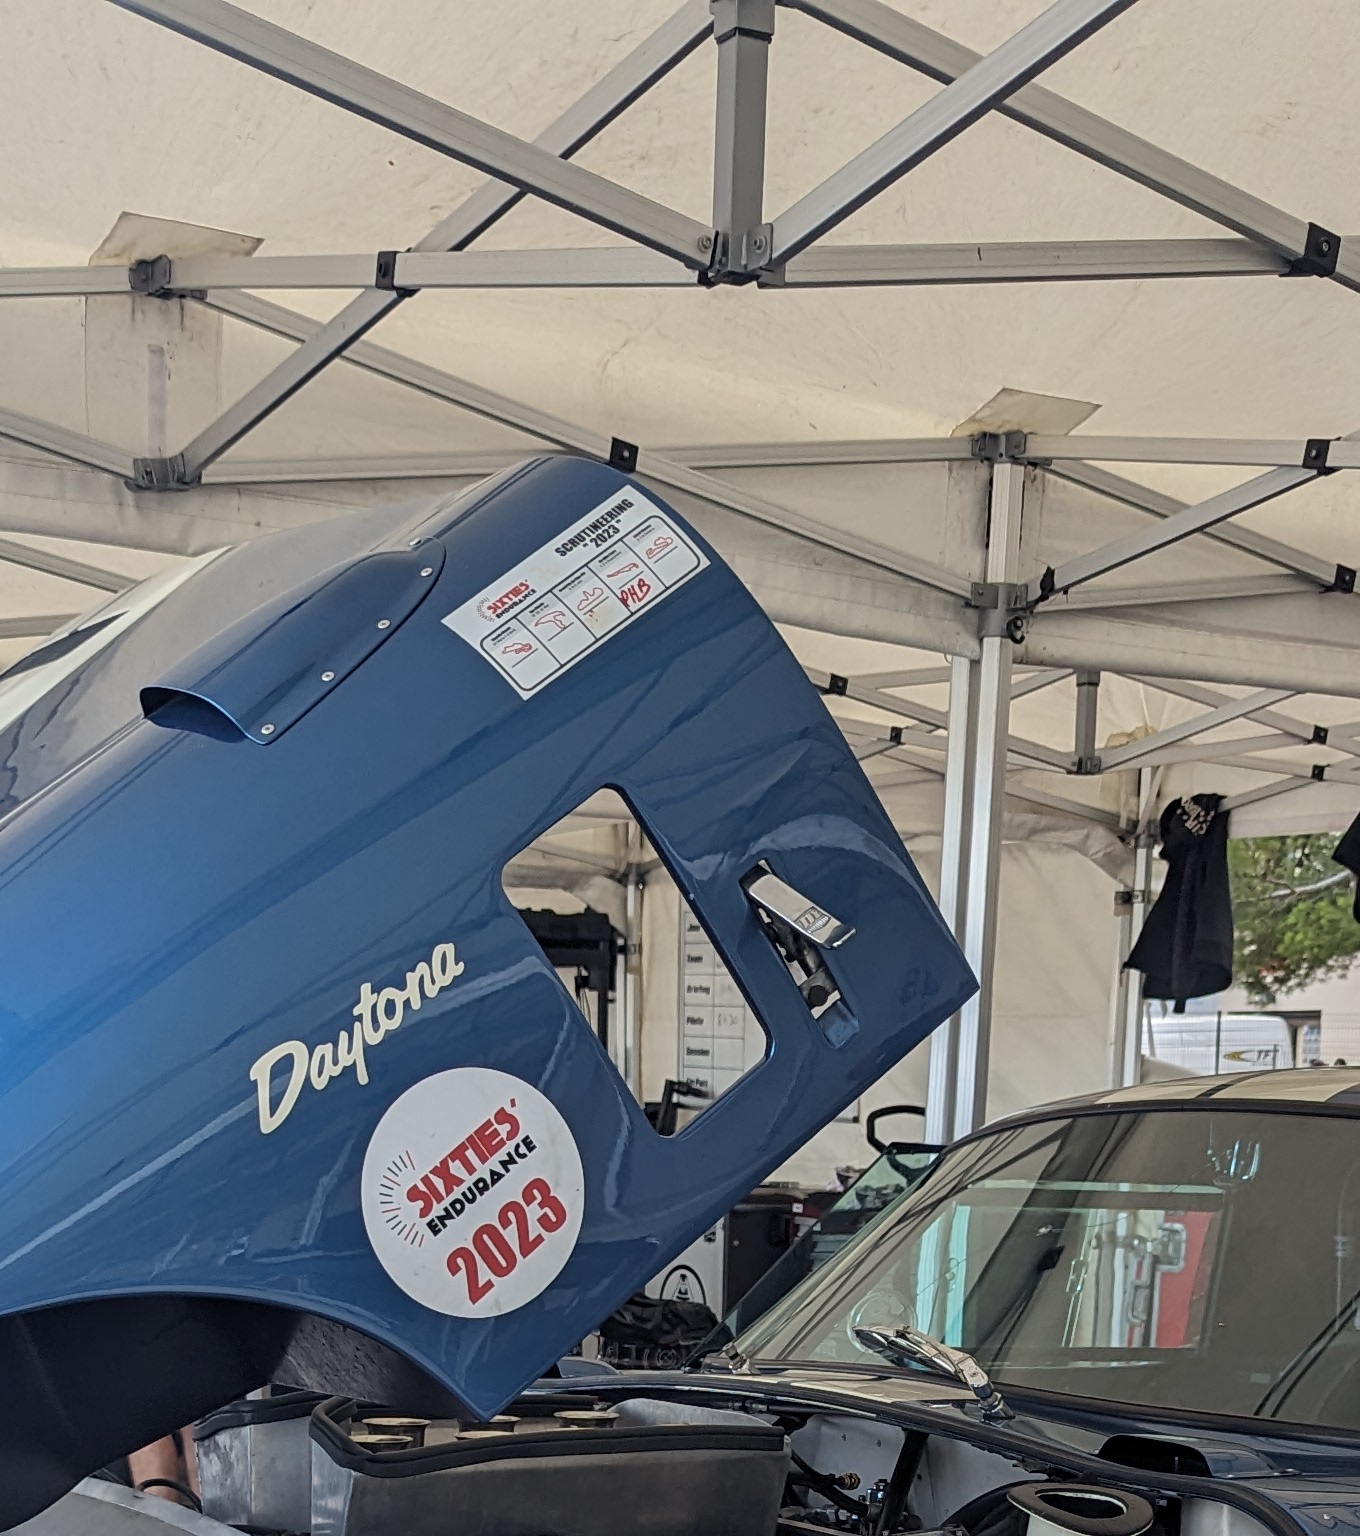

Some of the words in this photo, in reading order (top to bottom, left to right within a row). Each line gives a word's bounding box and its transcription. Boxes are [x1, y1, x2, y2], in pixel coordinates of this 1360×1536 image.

[554, 498, 635, 557] SCRUTINEERING
[495, 588, 537, 619] ENDURANCE
[249, 942, 465, 1135] Daytona
[425, 1134, 537, 1237] ENDURANCE
[446, 1176, 568, 1306] 2023
